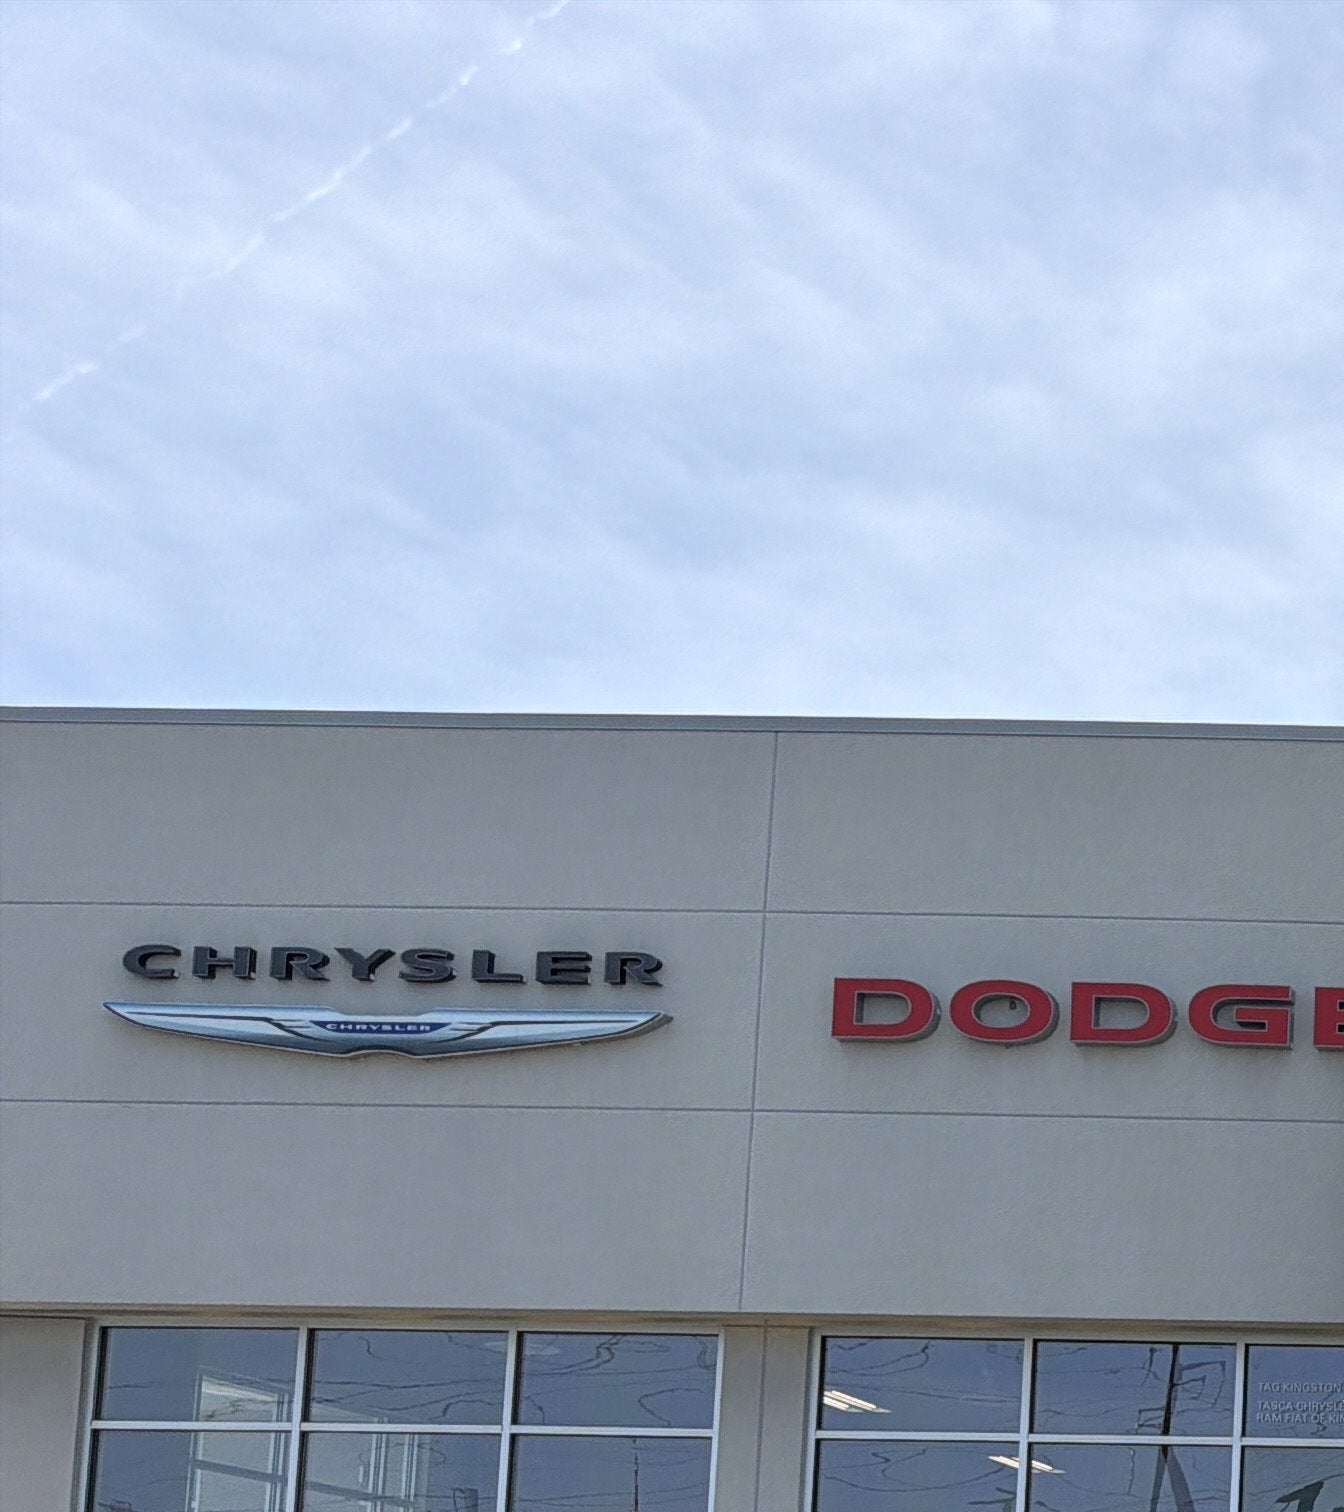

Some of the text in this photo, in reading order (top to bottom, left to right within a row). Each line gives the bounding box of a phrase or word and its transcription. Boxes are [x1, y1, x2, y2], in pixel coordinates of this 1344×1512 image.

[123, 944, 663, 987] CHRYSLER
[326, 1023, 431, 1031] CHRYSLER
[1259, 1382, 1281, 1392] TAG
[1283, 1383, 1342, 1393] KINGSTON
[1311, 1414, 1326, 1423] OF
